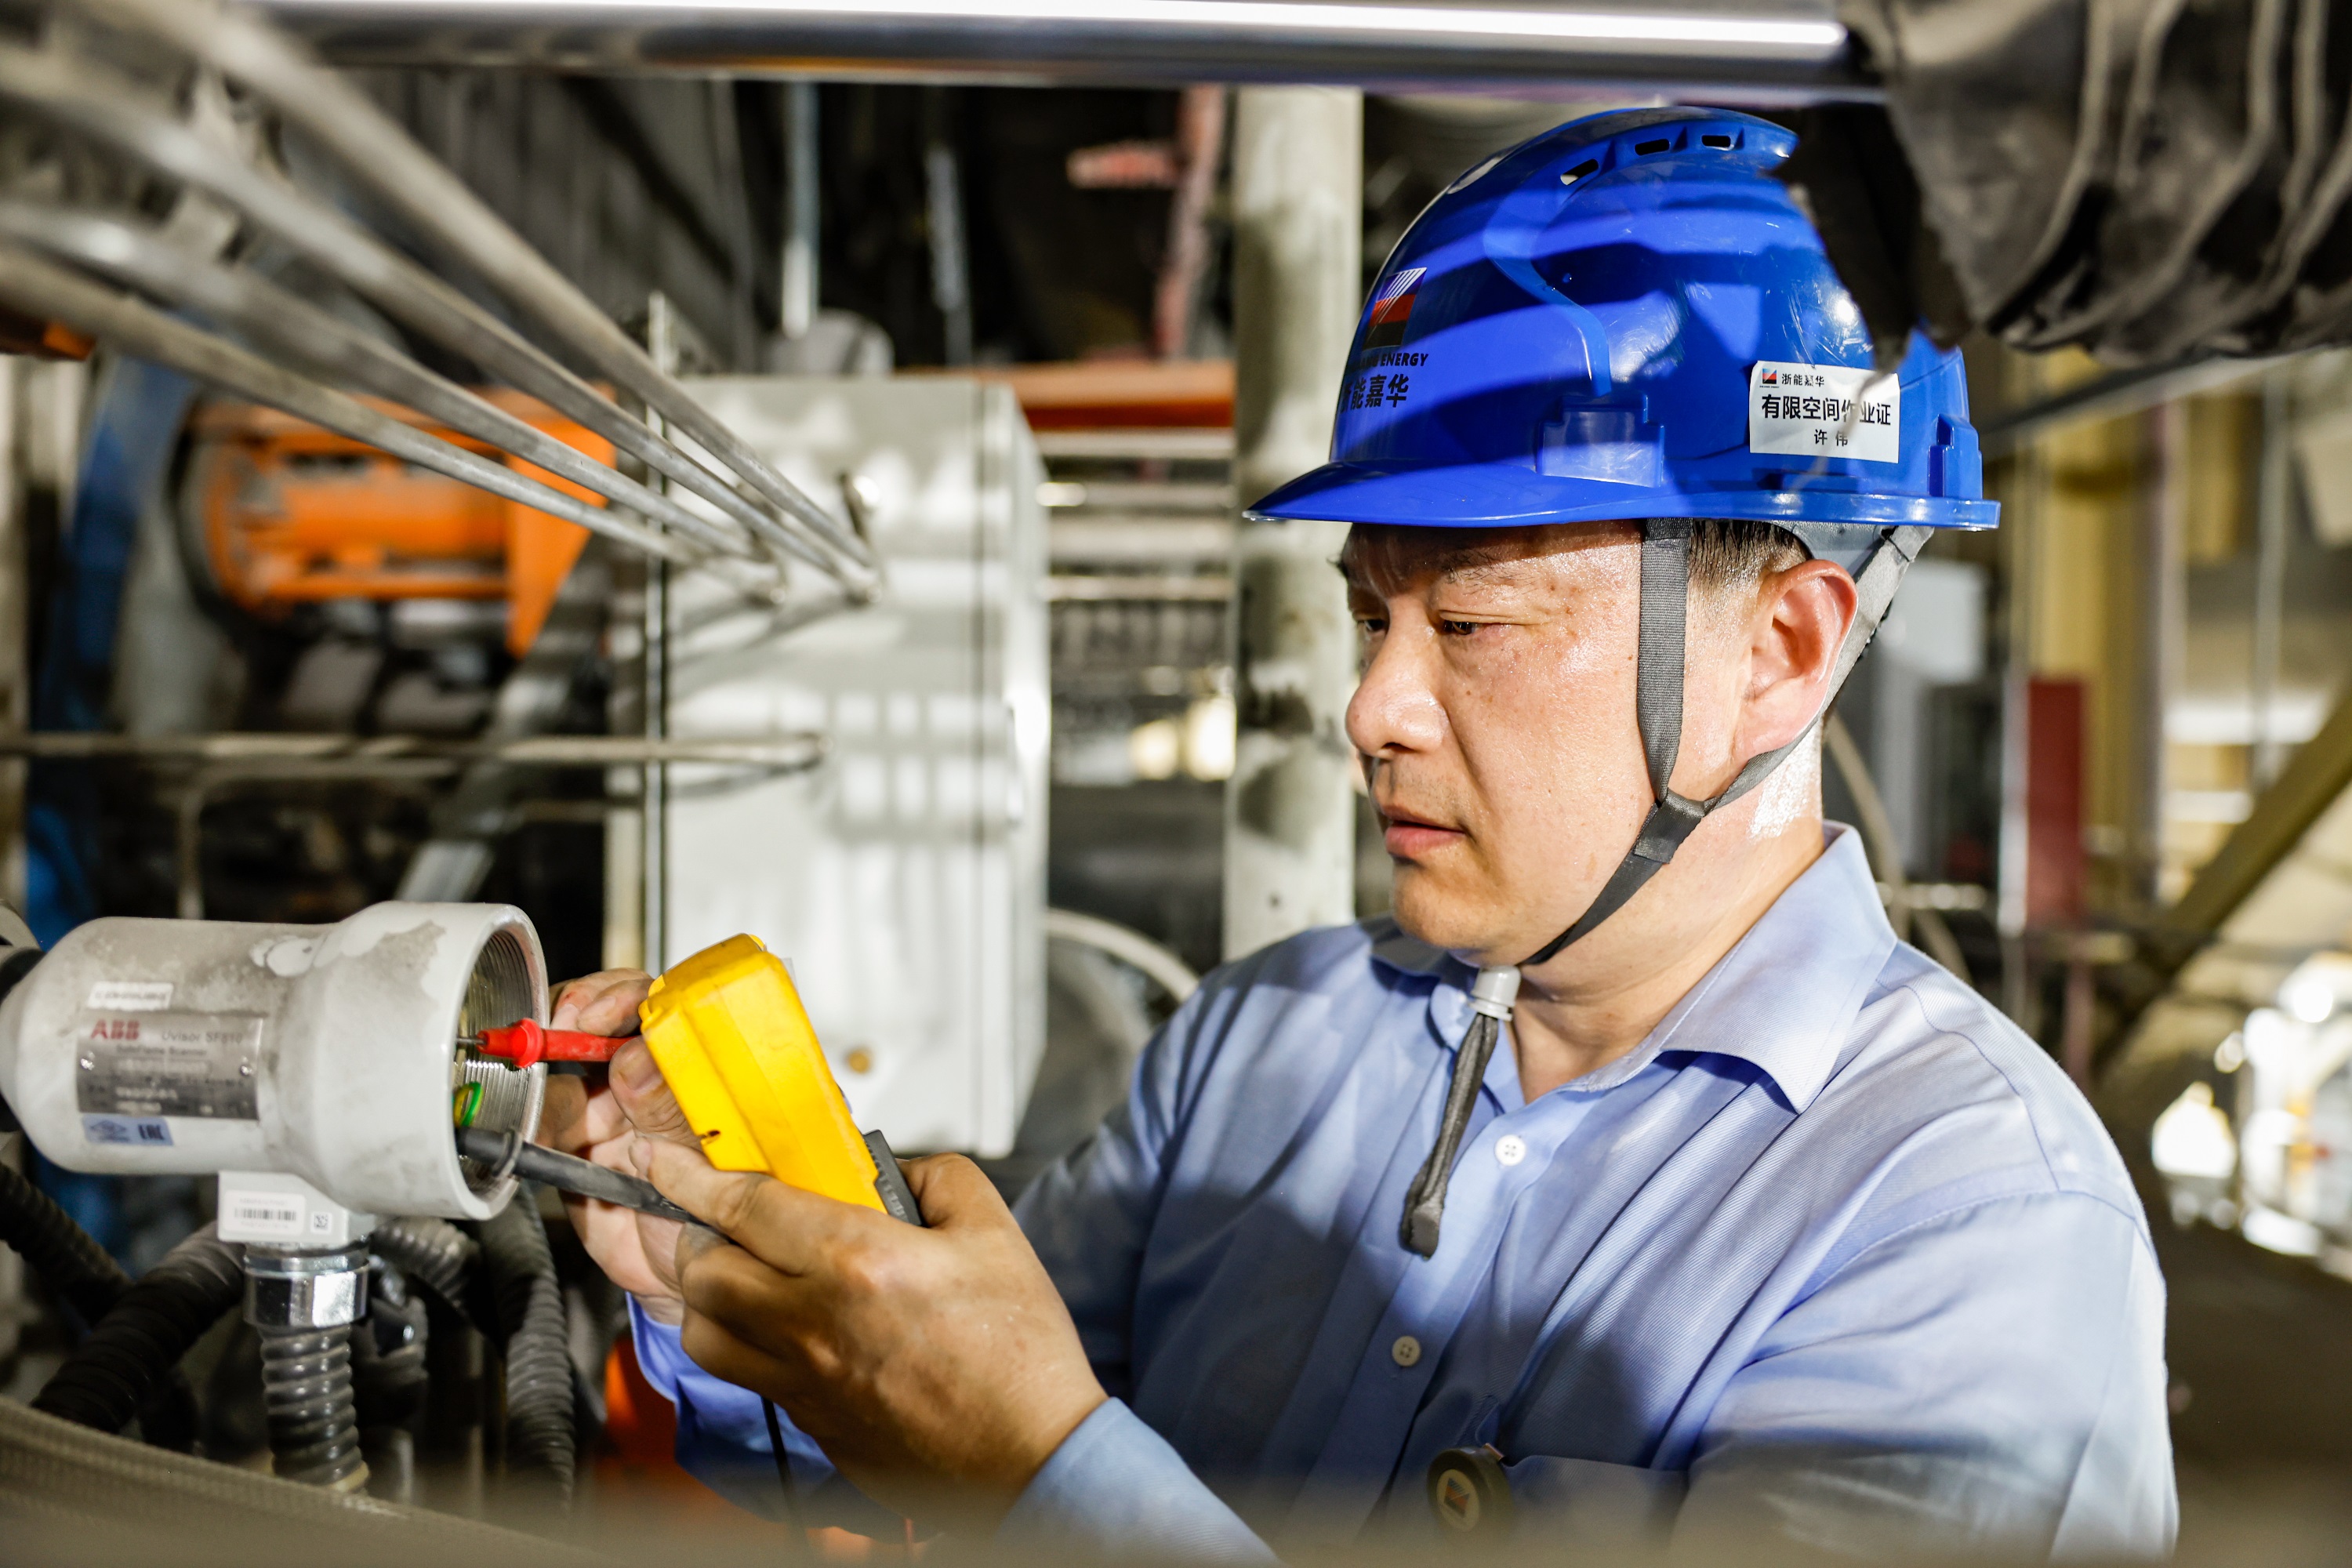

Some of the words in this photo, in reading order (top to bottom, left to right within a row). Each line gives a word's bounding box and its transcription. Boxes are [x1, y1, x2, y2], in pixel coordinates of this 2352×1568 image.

[1380, 352, 1429, 367] ENERGY
[1781, 372, 1825, 387] 浙能嘉华
[1761, 394, 1892, 426] 有限空间作业证
[90, 1019, 140, 1040] ABB
